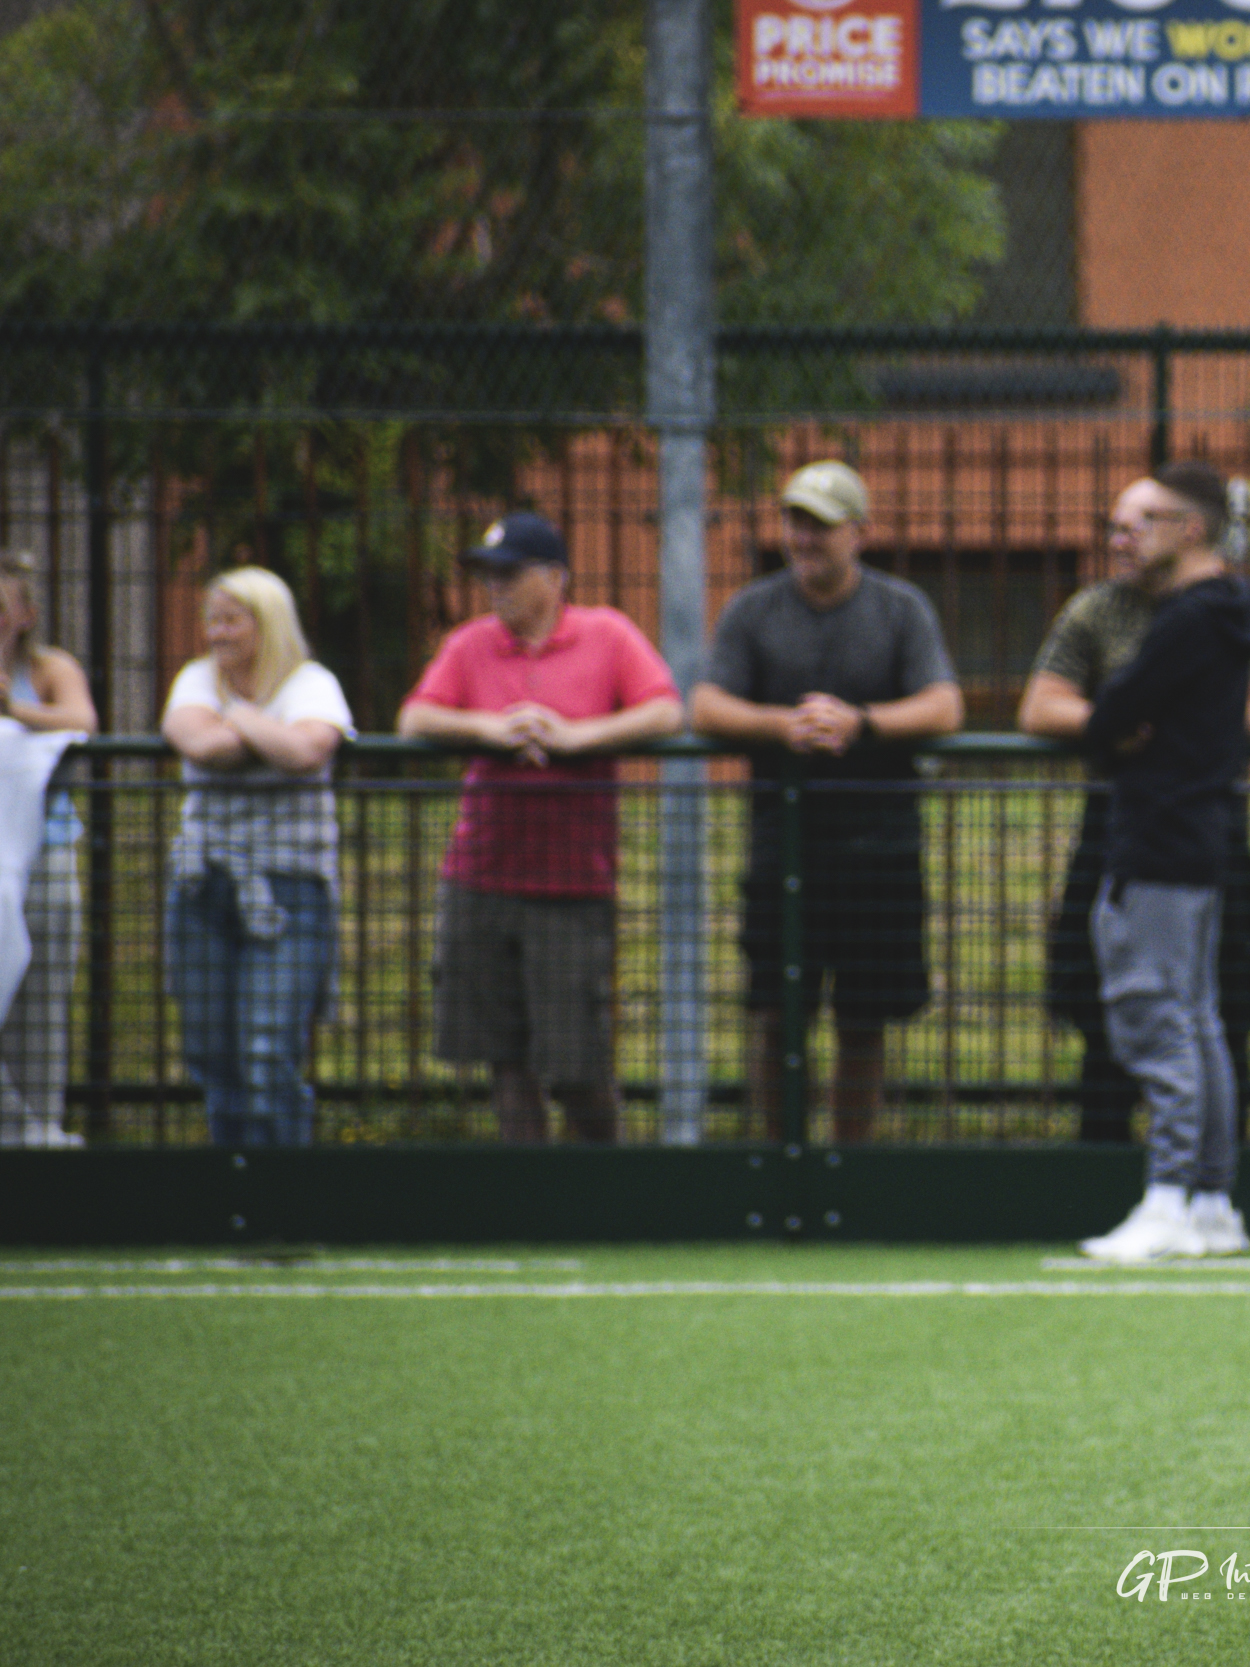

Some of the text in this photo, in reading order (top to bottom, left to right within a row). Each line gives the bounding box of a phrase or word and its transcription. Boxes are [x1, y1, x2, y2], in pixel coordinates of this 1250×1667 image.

[753, 15, 902, 55] PRICE
[961, 18, 1077, 60] SAYS
[1083, 20, 1159, 60] WE
[753, 60, 898, 88] PROMISE
[972, 64, 1145, 104] BEATEN
[1152, 64, 1228, 105] ON
